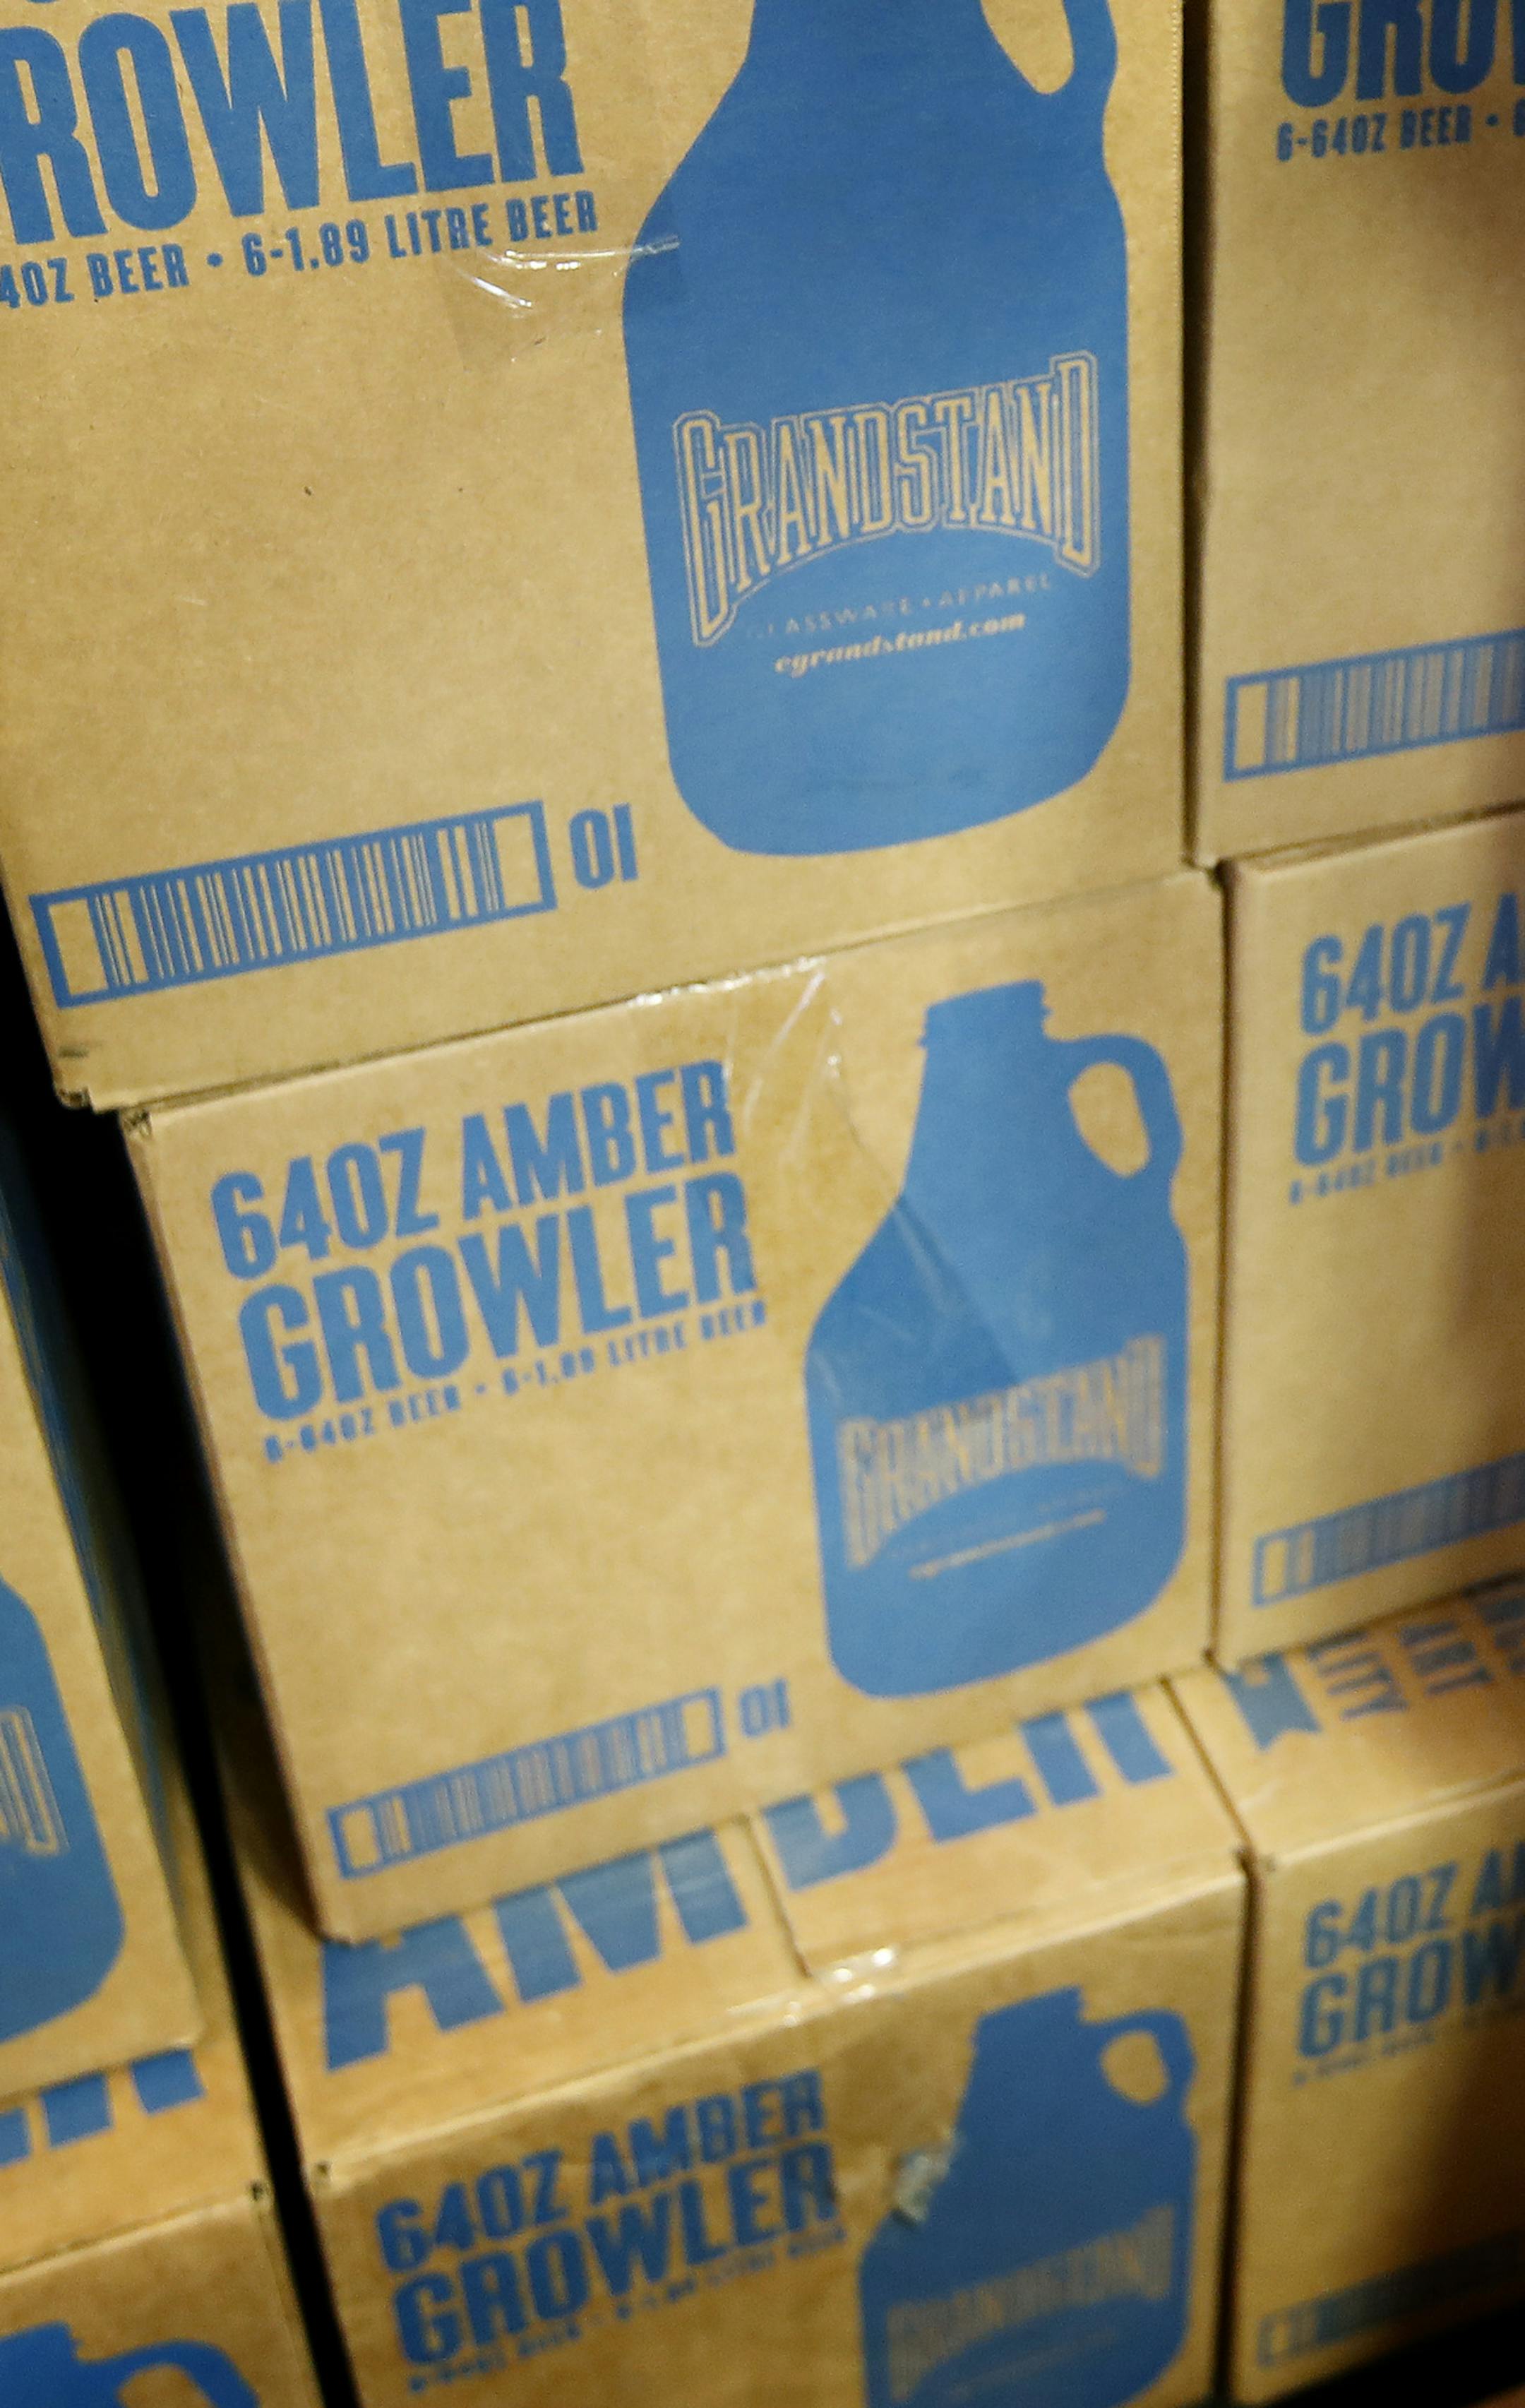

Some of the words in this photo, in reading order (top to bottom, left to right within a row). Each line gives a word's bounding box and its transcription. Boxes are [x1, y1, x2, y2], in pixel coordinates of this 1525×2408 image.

[1281, 0, 1525, 107] GRO
[1400, 104, 1471, 150] BEER
[86, 243, 189, 298] BEER
[241, 221, 370, 277] 6-1.89
[385, 203, 492, 259] LITRE
[507, 190, 597, 243] BEER
[672, 350, 1101, 647] GRANDSTAND
[461, 1059, 736, 1220] AMBER
[239, 1171, 758, 1422] GROWLER
[589, 2068, 826, 2206] AMBER
[393, 2140, 840, 2366] GROWLER
